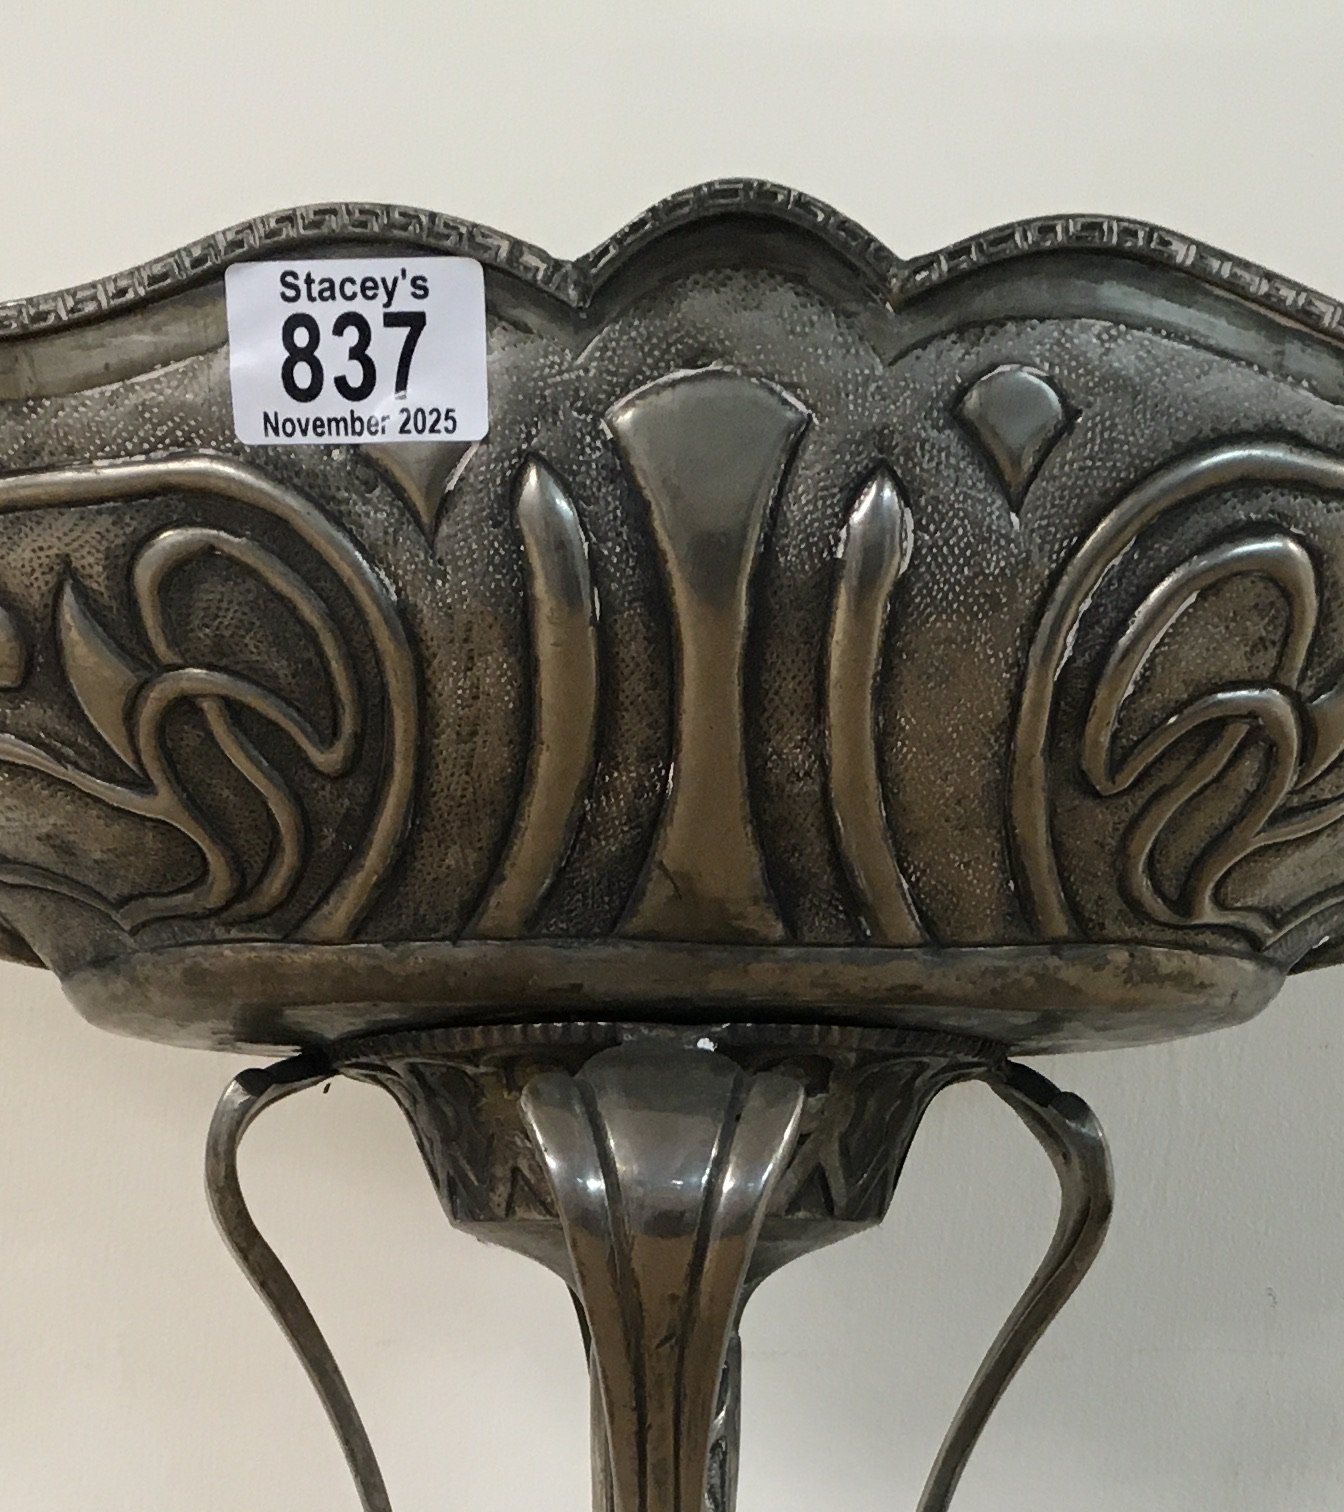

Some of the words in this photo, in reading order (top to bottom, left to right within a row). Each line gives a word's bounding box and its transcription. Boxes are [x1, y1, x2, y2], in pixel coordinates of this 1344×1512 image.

[279, 267, 430, 308] Stacey's
[281, 311, 427, 403] 837
[263, 409, 390, 437] November
[398, 407, 458, 435] 2025
